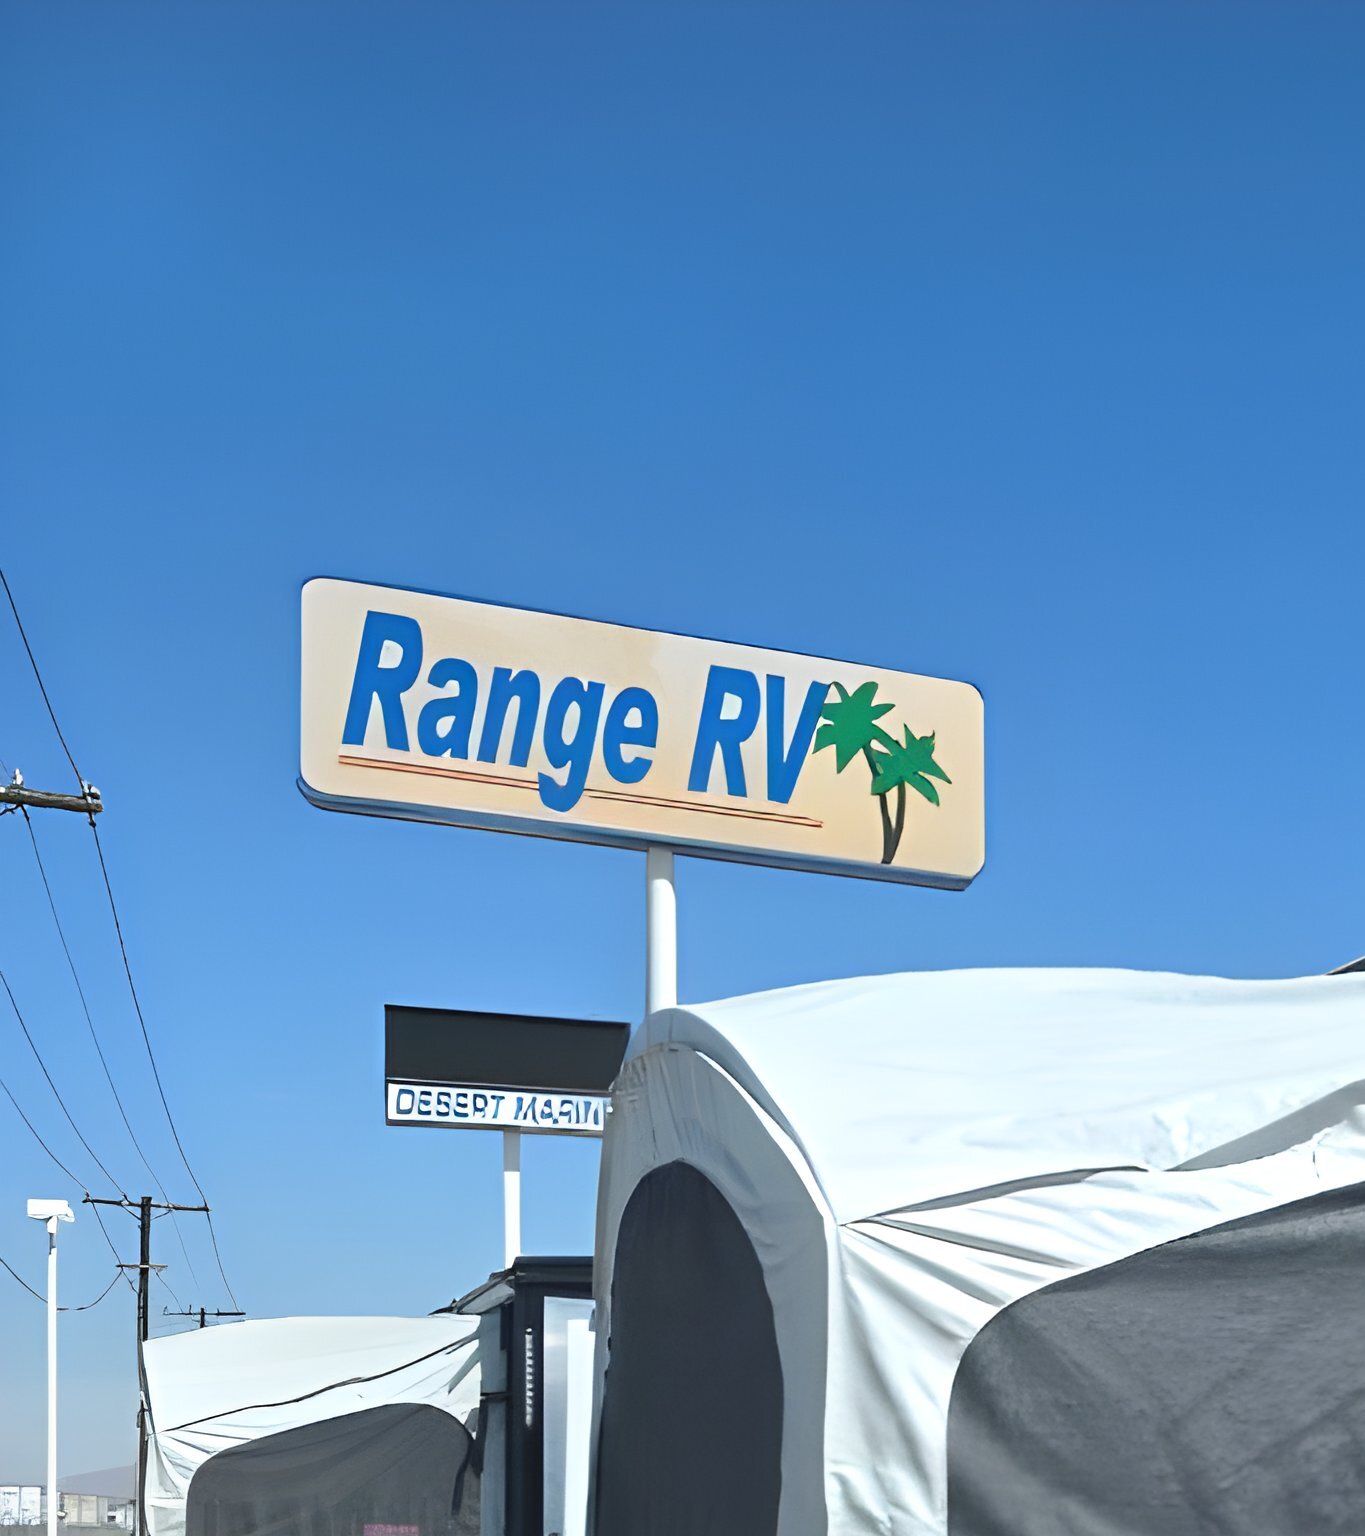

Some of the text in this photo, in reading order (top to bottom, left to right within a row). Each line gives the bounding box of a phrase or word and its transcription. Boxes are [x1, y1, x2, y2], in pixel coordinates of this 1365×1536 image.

[341, 609, 832, 814] Range RV
[395, 1088, 602, 1126] DESERT MARIN
